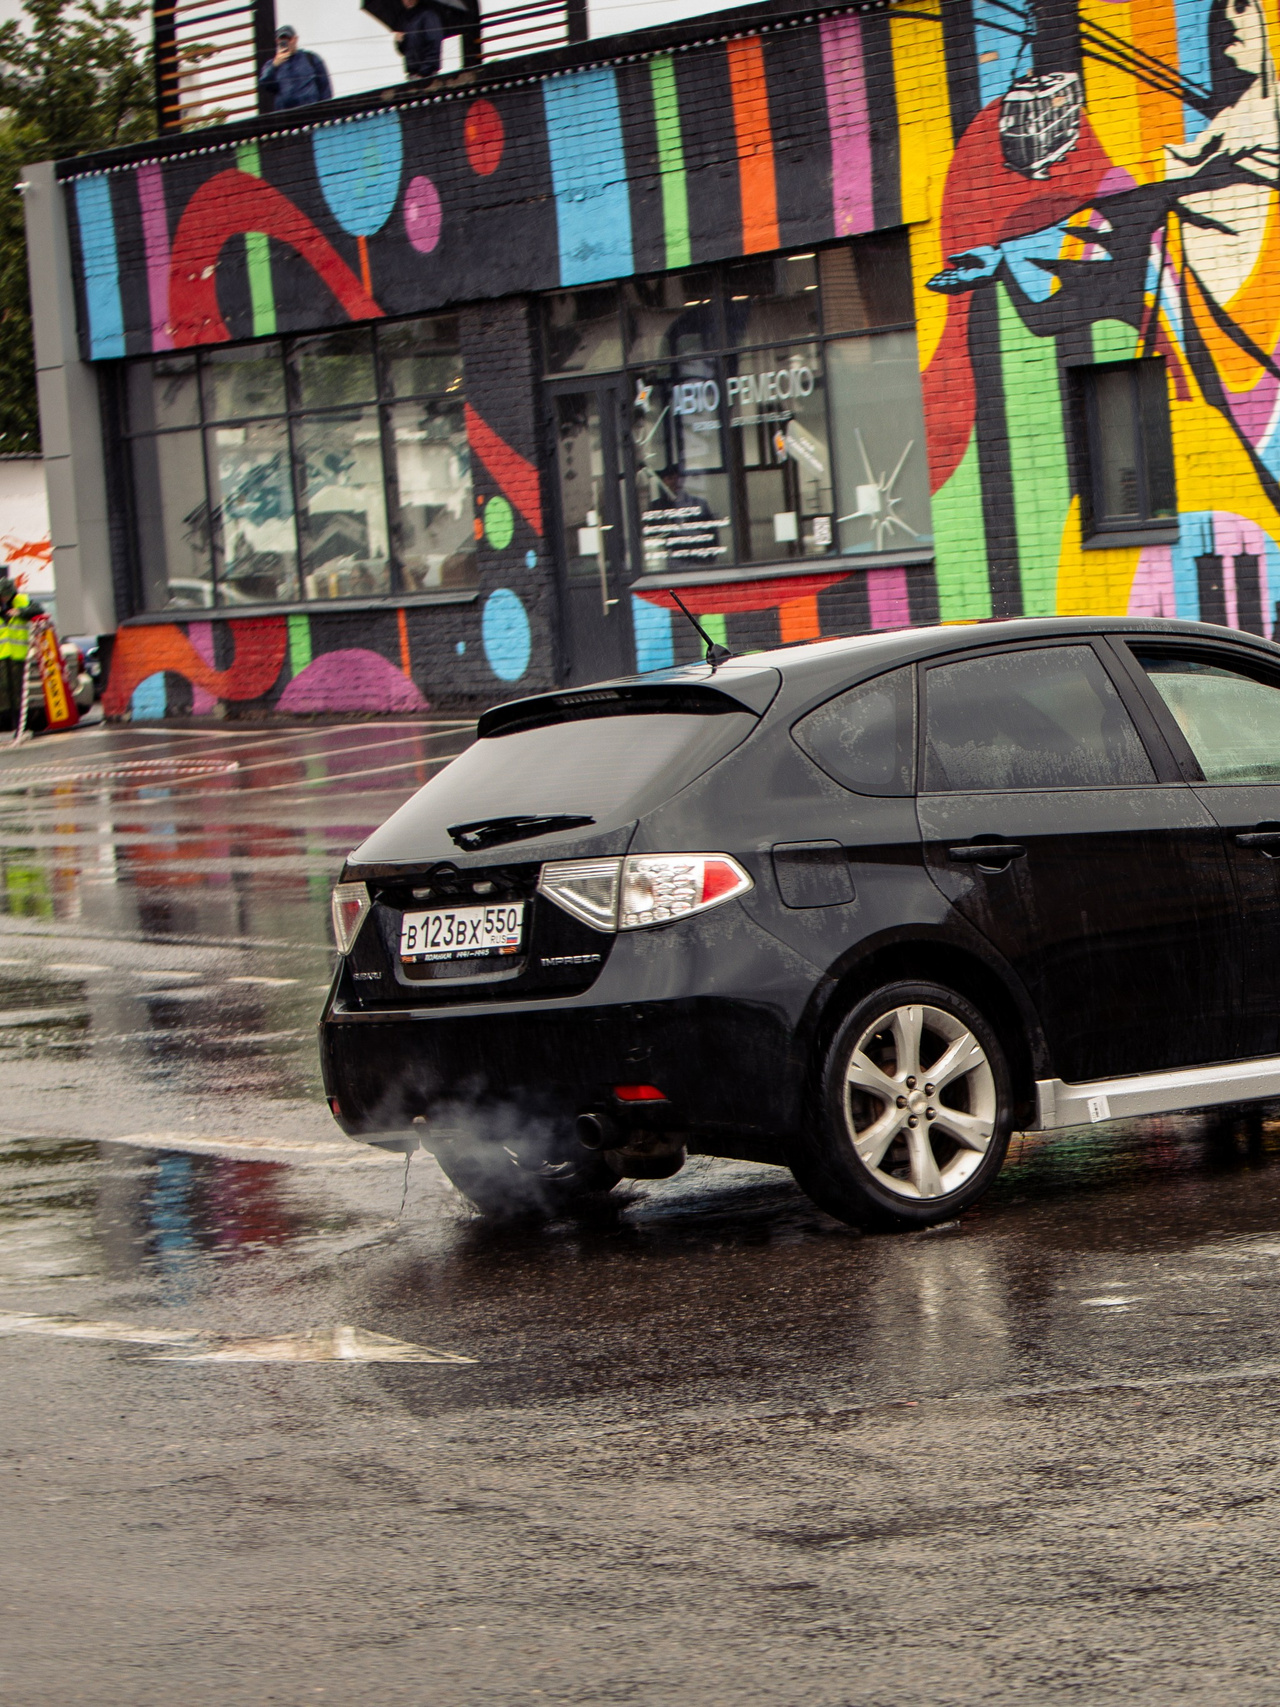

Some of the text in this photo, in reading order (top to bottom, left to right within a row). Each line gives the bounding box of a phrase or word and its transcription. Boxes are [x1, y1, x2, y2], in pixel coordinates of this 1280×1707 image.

[672, 379, 720, 416] АВТО
[484, 908, 517, 934] 550
[490, 934, 506, 944] RUS
[540, 953, 601, 967] IMPREZA
